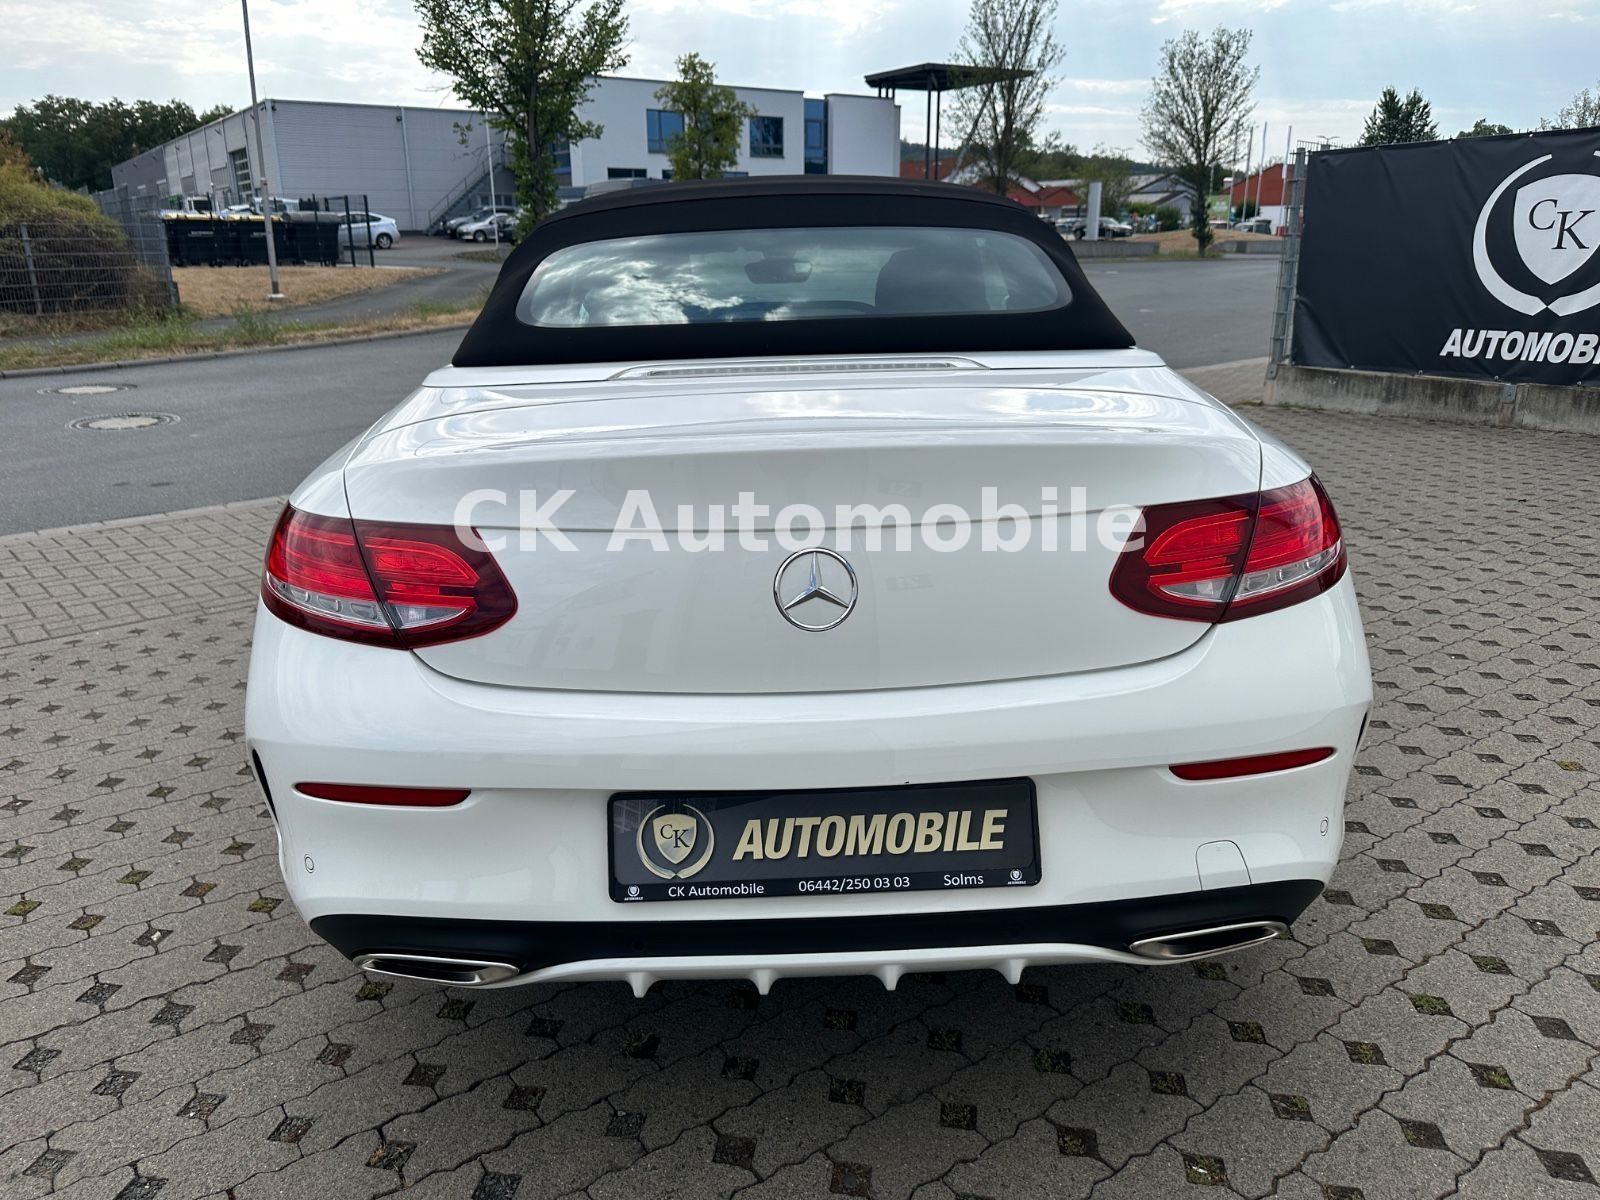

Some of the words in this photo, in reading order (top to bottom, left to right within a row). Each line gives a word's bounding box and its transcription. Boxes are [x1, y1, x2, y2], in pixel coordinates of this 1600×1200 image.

[1529, 199, 1595, 249] CK
[660, 824, 690, 848] CK
[732, 809, 1008, 861] AUTOMOBILE
[668, 886, 685, 897] CK
[688, 883, 765, 897] Automobile
[798, 878, 870, 892] 06442/250
[874, 876, 890, 888] 03
[894, 875, 910, 887] 03
[943, 873, 984, 886] Solms
